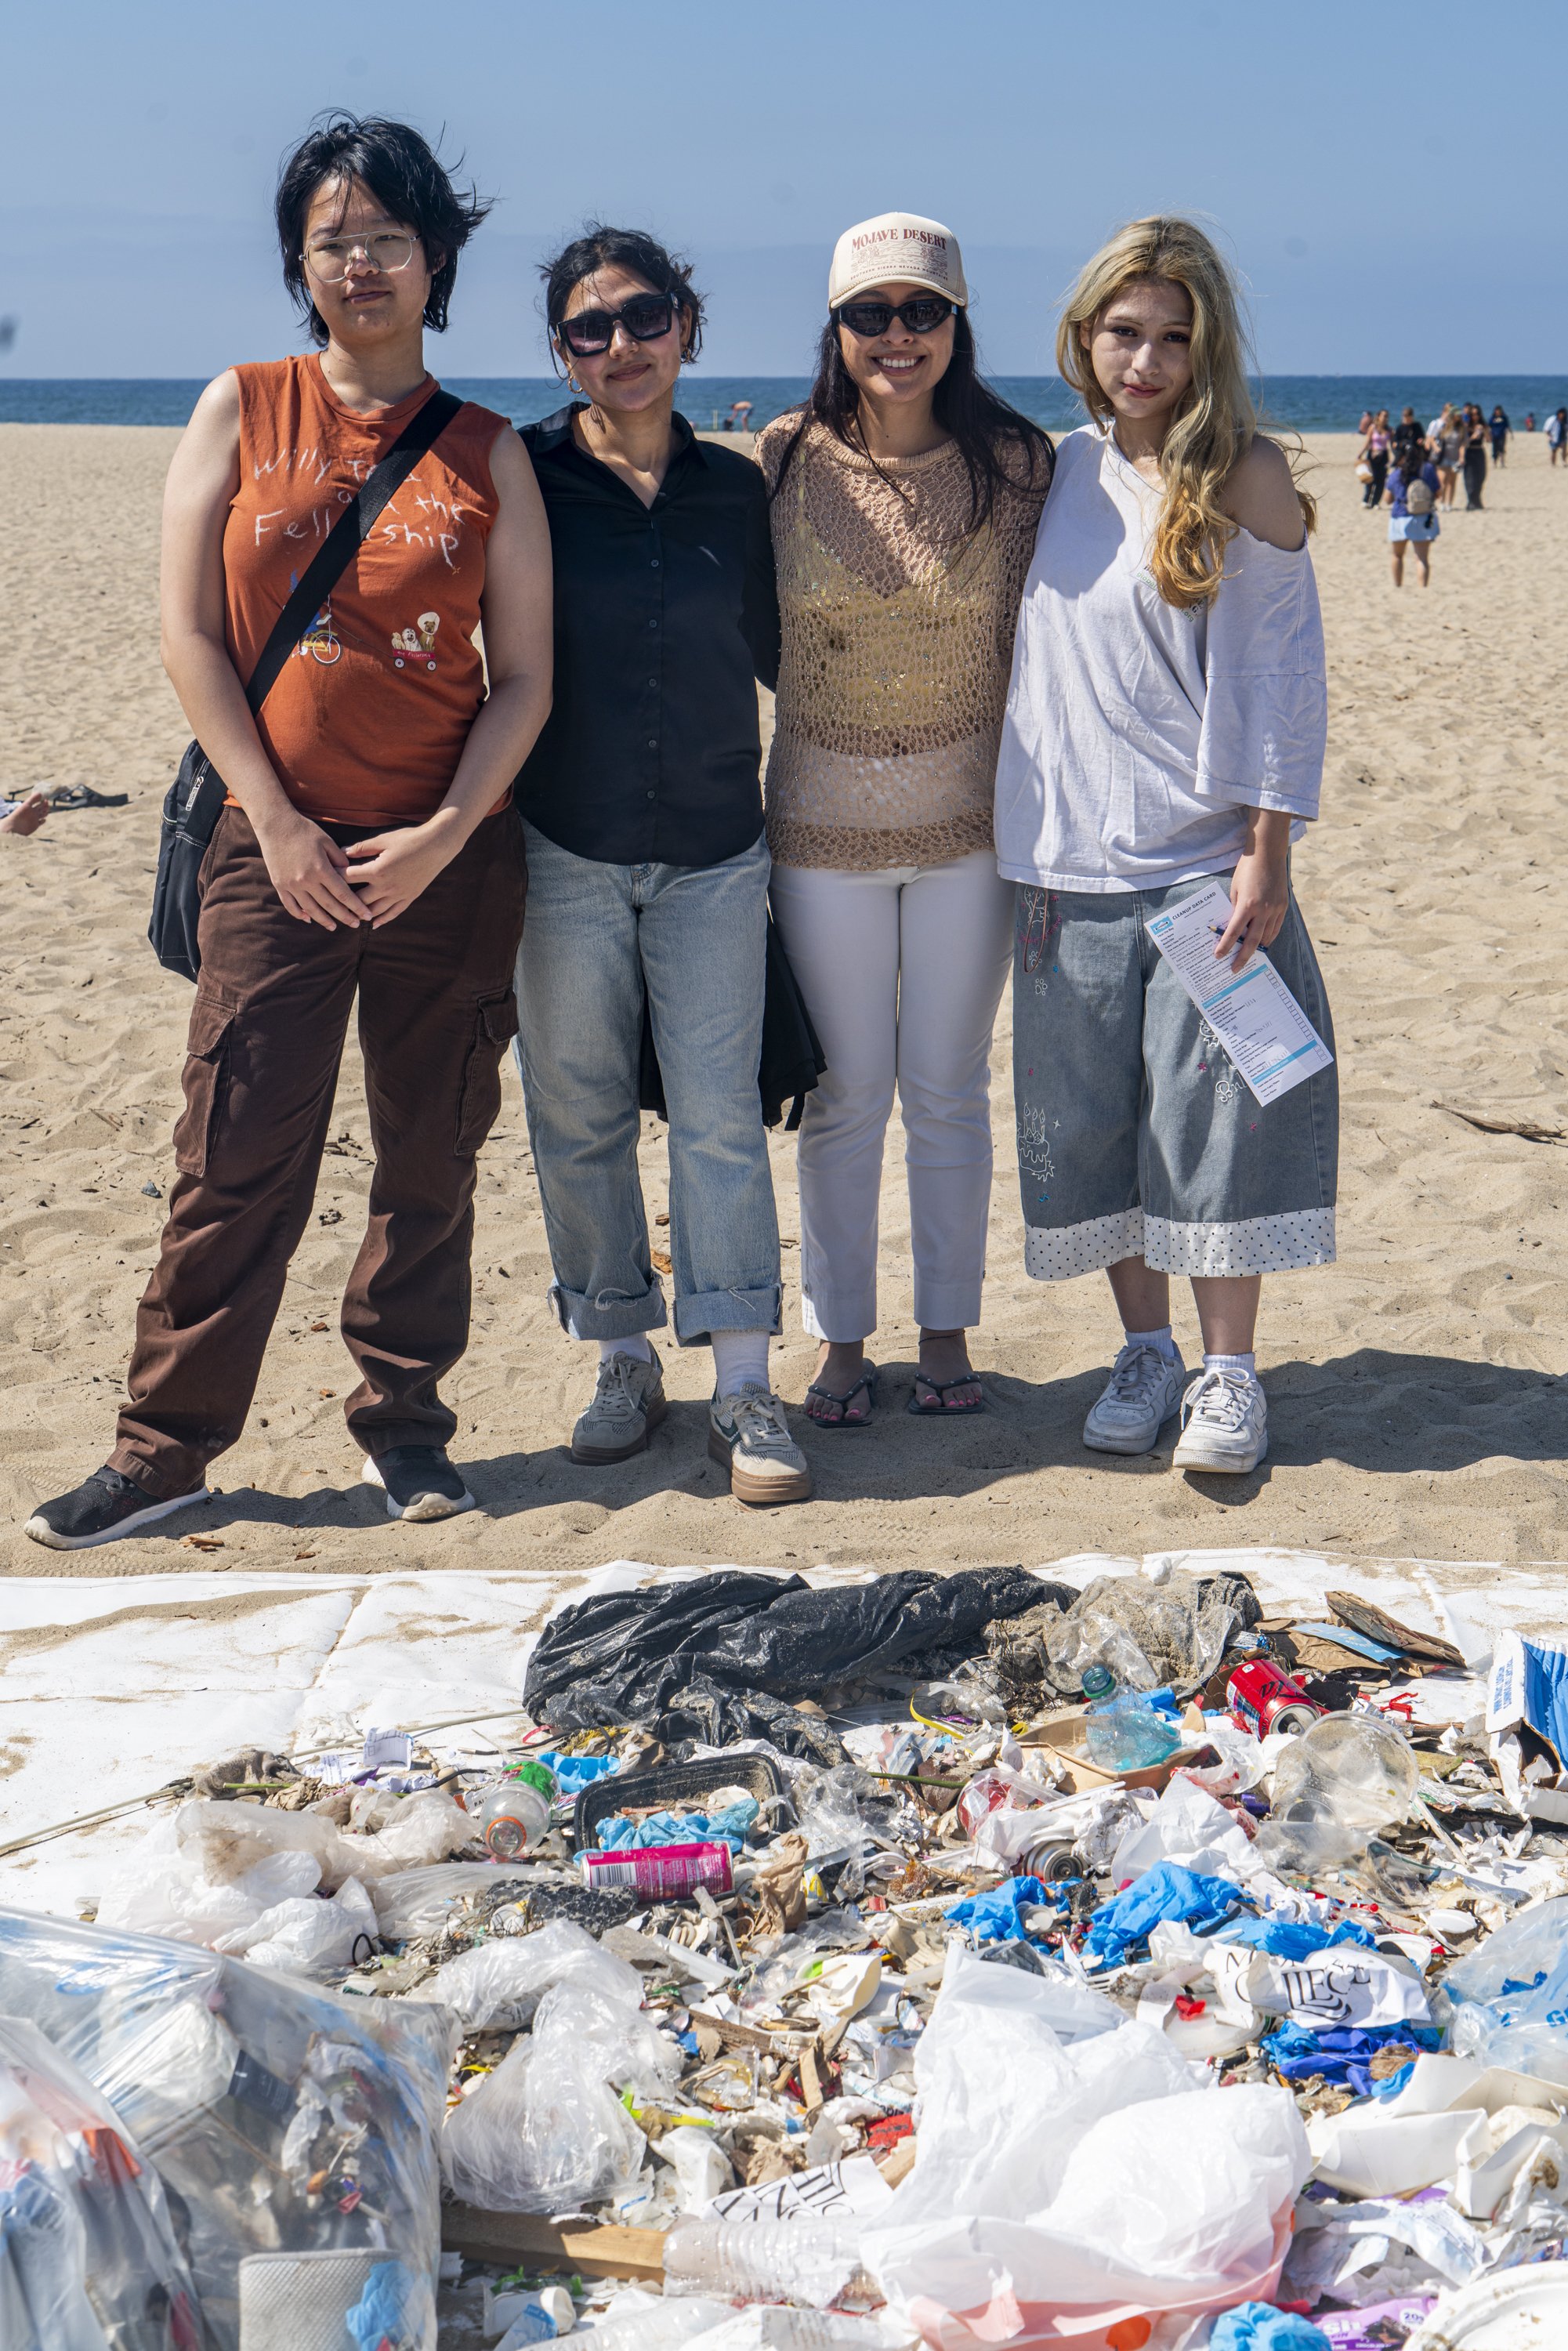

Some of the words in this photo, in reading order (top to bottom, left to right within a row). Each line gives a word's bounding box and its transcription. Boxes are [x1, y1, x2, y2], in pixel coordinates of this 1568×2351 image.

[852, 228, 898, 253] MOJAVE
[904, 228, 947, 251] DESERT
[922, 268, 948, 281] MOUNTAINS
[253, 447, 332, 485] Willy
[415, 491, 465, 525] the
[255, 508, 458, 569] Fellship
[1171, 905, 1192, 920] CLEANUP
[1191, 899, 1204, 908] DATA
[1203, 891, 1216, 901] CARD
